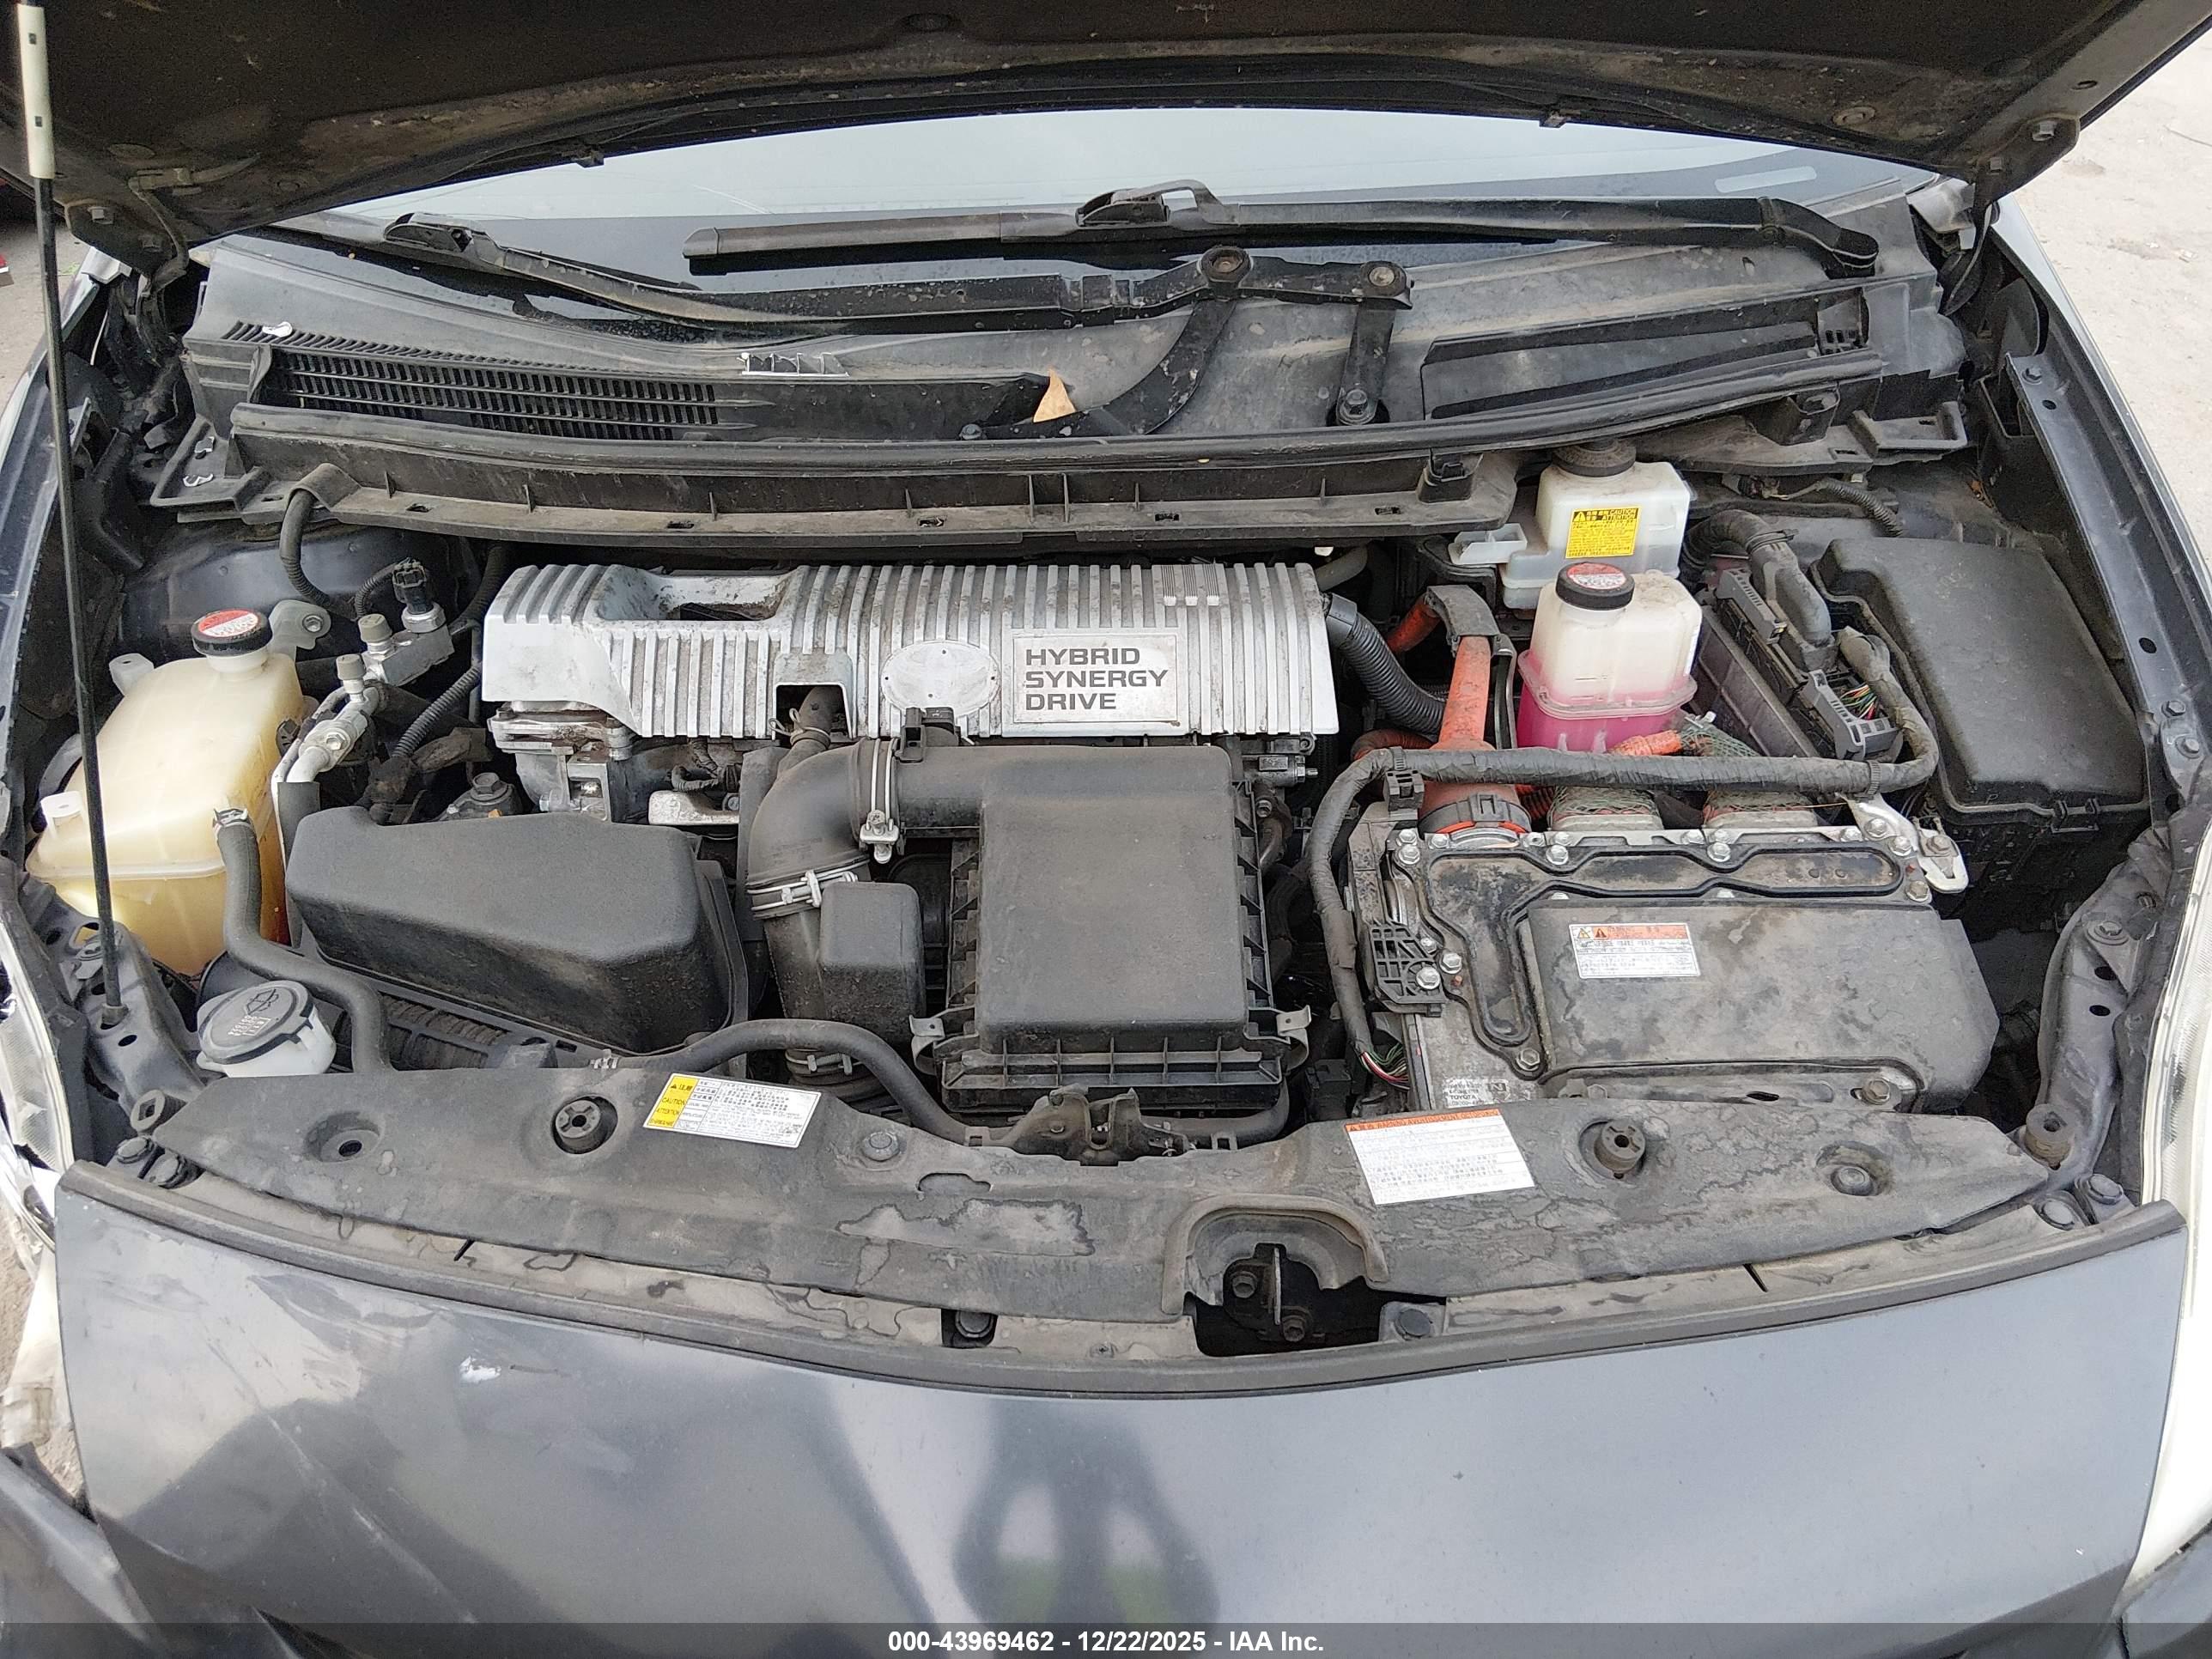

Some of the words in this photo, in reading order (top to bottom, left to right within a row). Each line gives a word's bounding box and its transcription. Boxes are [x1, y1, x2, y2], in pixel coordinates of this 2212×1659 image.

[1025, 647, 1140, 665] HYBRID
[1025, 670, 1169, 689] SYNERGY
[1025, 693, 1117, 711] DRIVE
[661, 1097, 685, 1106] CAUTION
